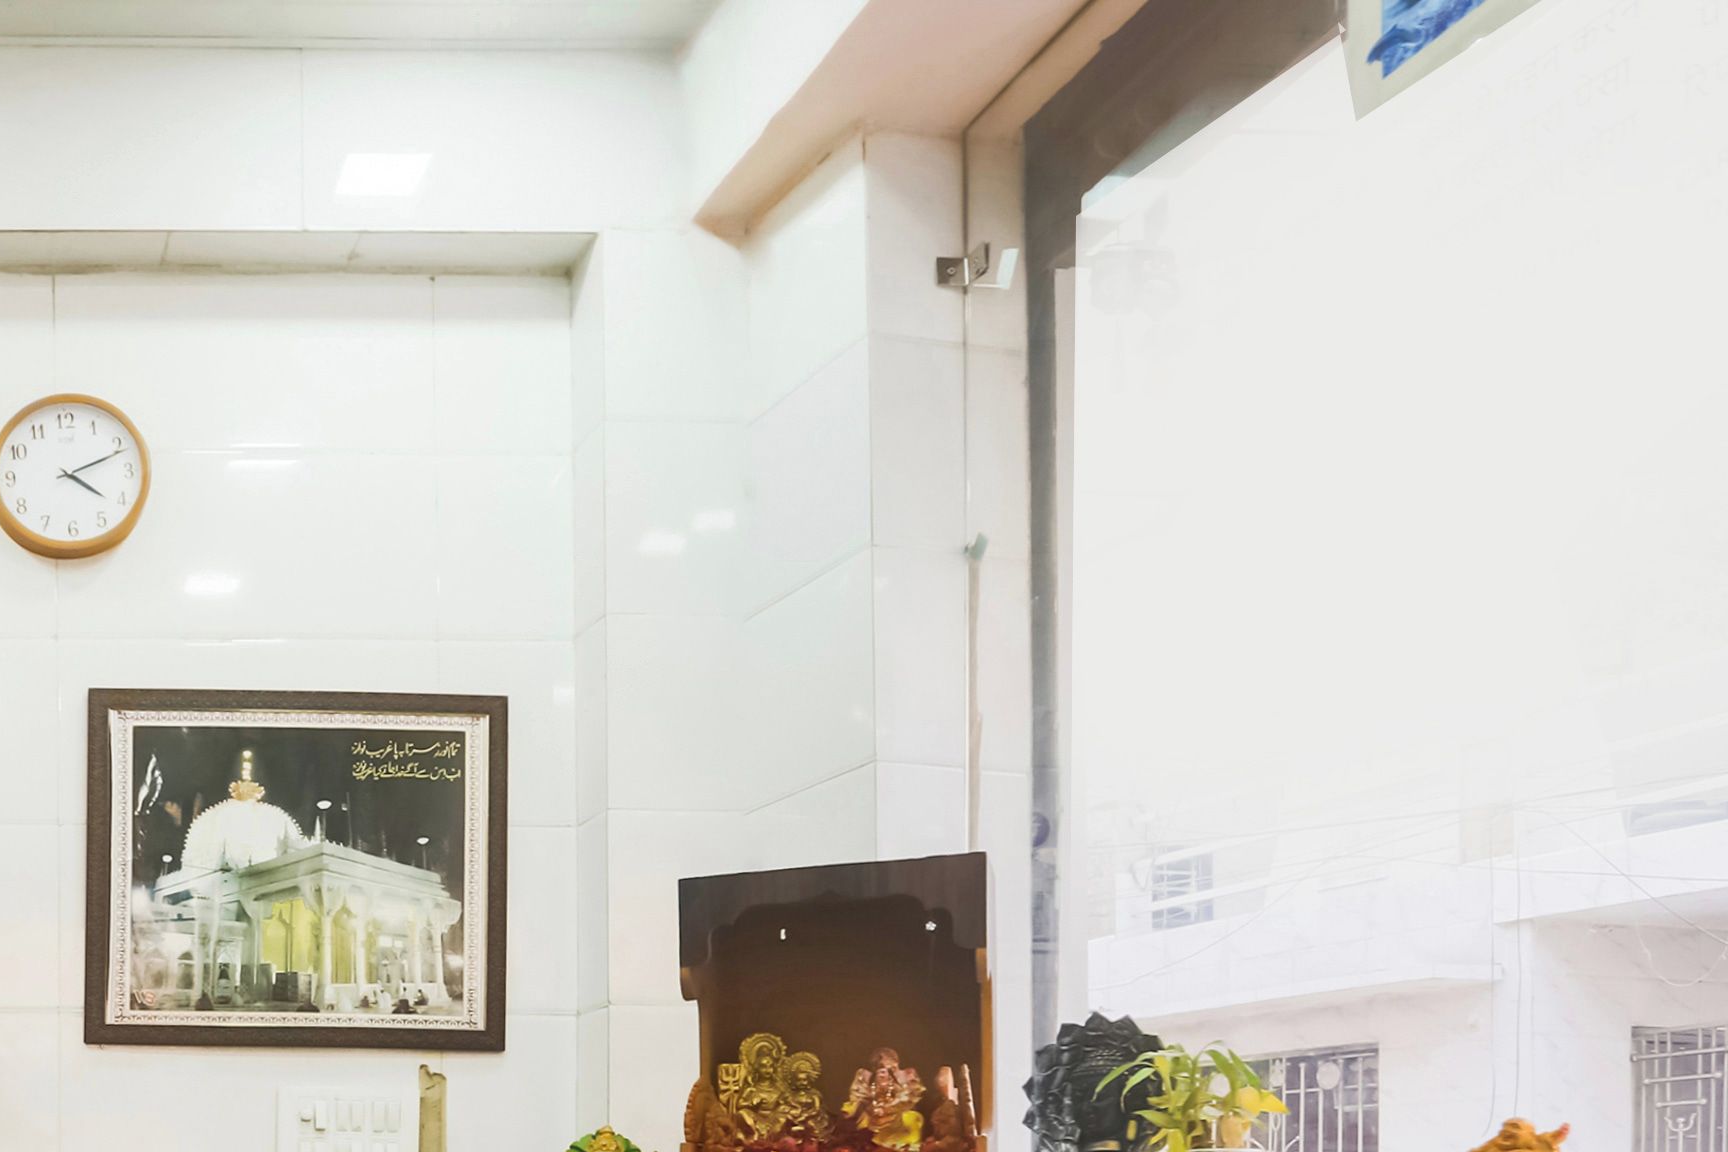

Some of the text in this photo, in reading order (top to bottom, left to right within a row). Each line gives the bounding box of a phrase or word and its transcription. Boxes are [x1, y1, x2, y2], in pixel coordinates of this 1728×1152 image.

[56, 411, 76, 430] 12
[90, 420, 98, 436] 1
[31, 424, 46, 440] 11
[10, 443, 28, 461] 10
[112, 436, 124, 455] 2
[5, 470, 16, 488] 9
[124, 462, 135, 479] 3
[16, 498, 28, 515] 8
[117, 491, 126, 507] 4
[40, 514, 51, 532] 7
[96, 511, 107, 528] 5
[67, 520, 80, 538] 6
